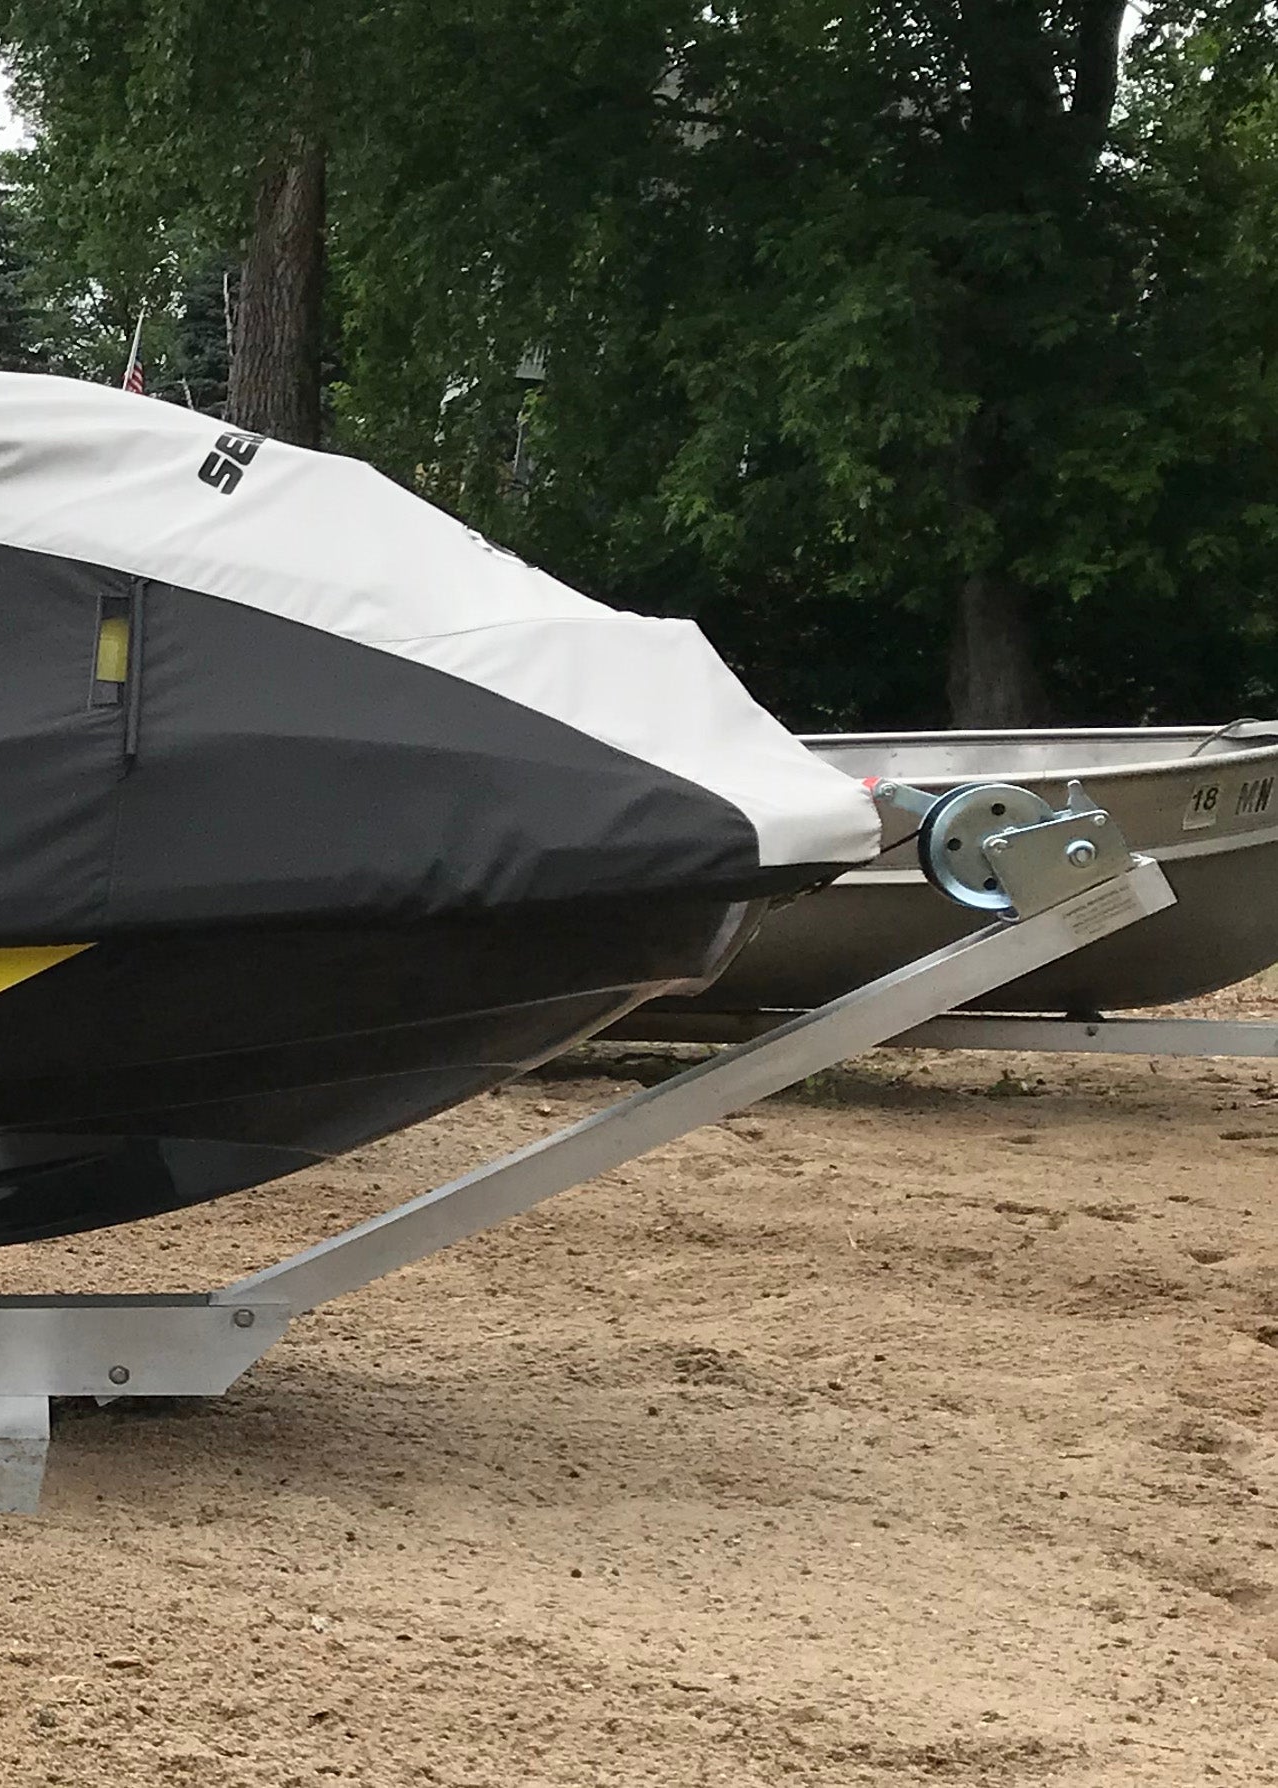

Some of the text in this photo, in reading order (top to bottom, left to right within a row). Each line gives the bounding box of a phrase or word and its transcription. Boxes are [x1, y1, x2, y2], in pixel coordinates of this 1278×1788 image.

[198, 432, 265, 495] SE
[1192, 776, 1275, 815] 18 MN
